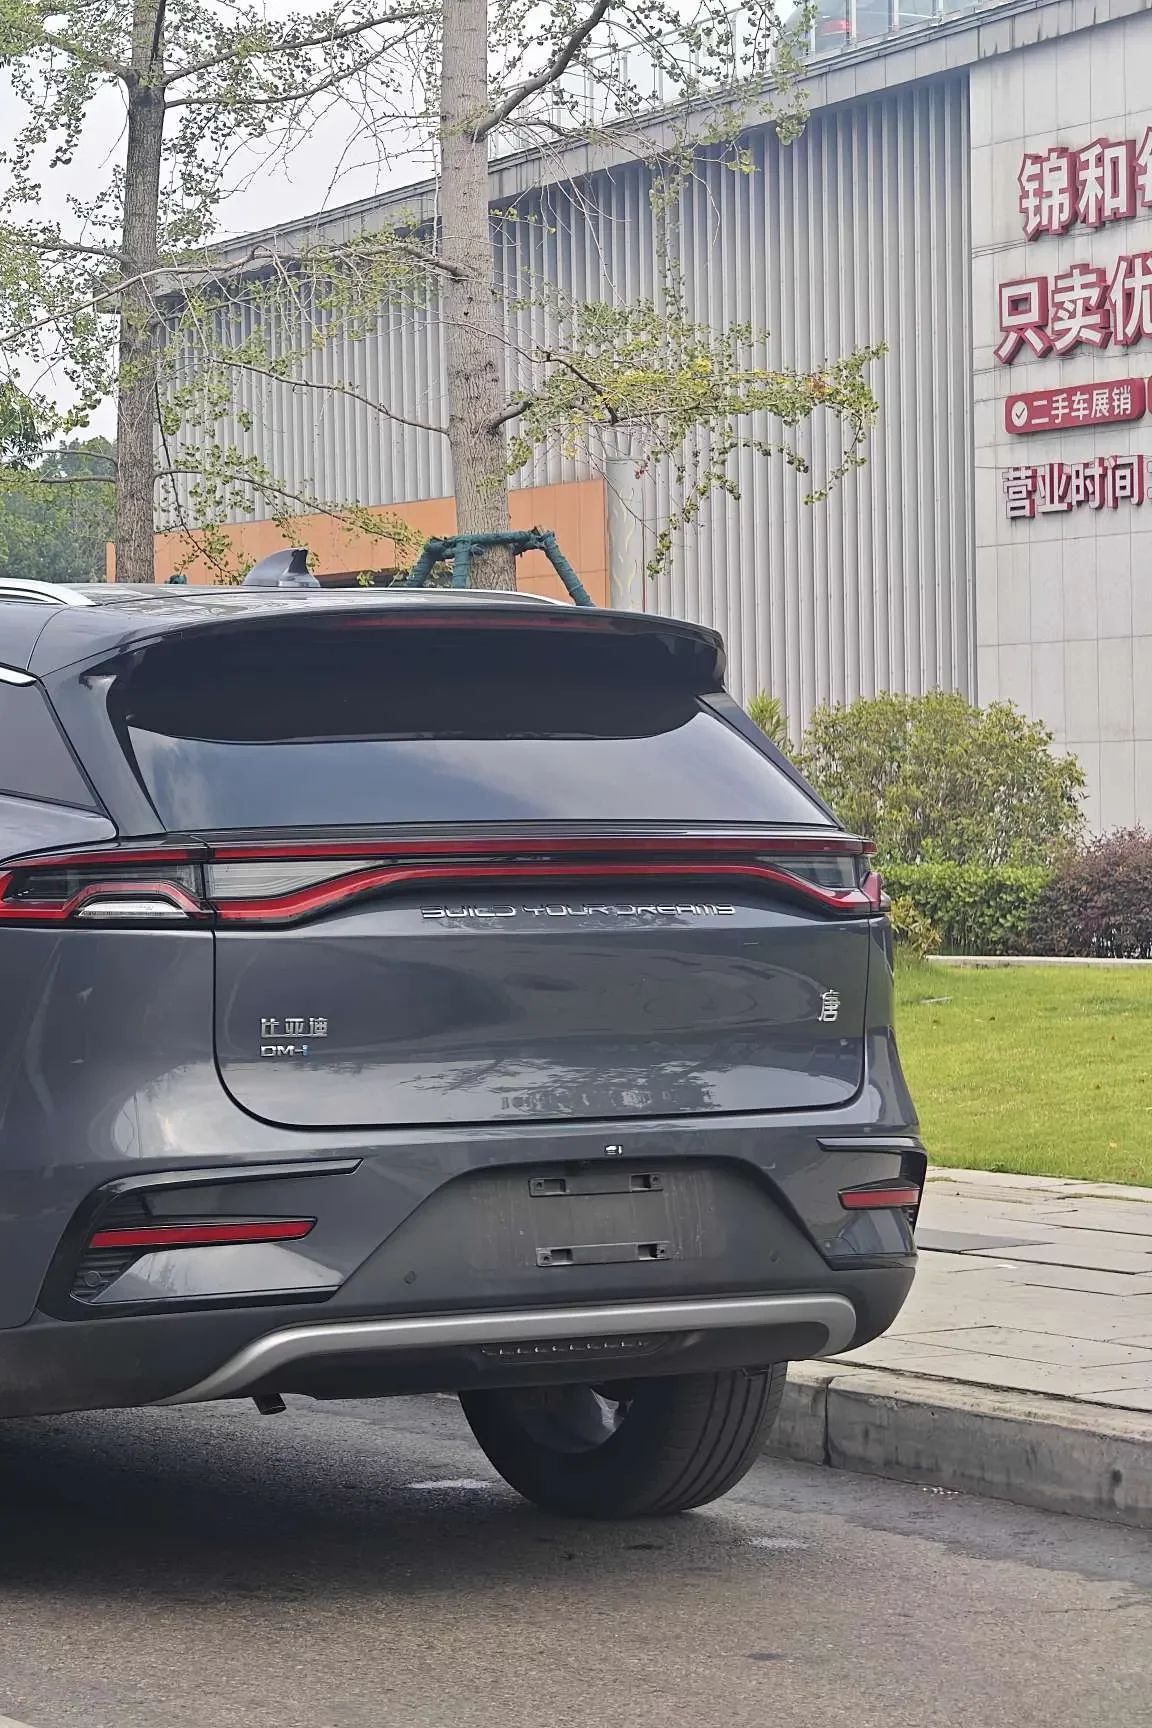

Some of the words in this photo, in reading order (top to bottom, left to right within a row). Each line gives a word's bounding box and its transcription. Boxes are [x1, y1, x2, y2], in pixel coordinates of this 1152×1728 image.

[1017, 127, 1152, 241] 锦和
[1030, 385, 1132, 424] 二手车展销
[421, 905, 517, 919] BUILD
[522, 904, 609, 917] YOUR
[613, 903, 736, 916] DREAMS
